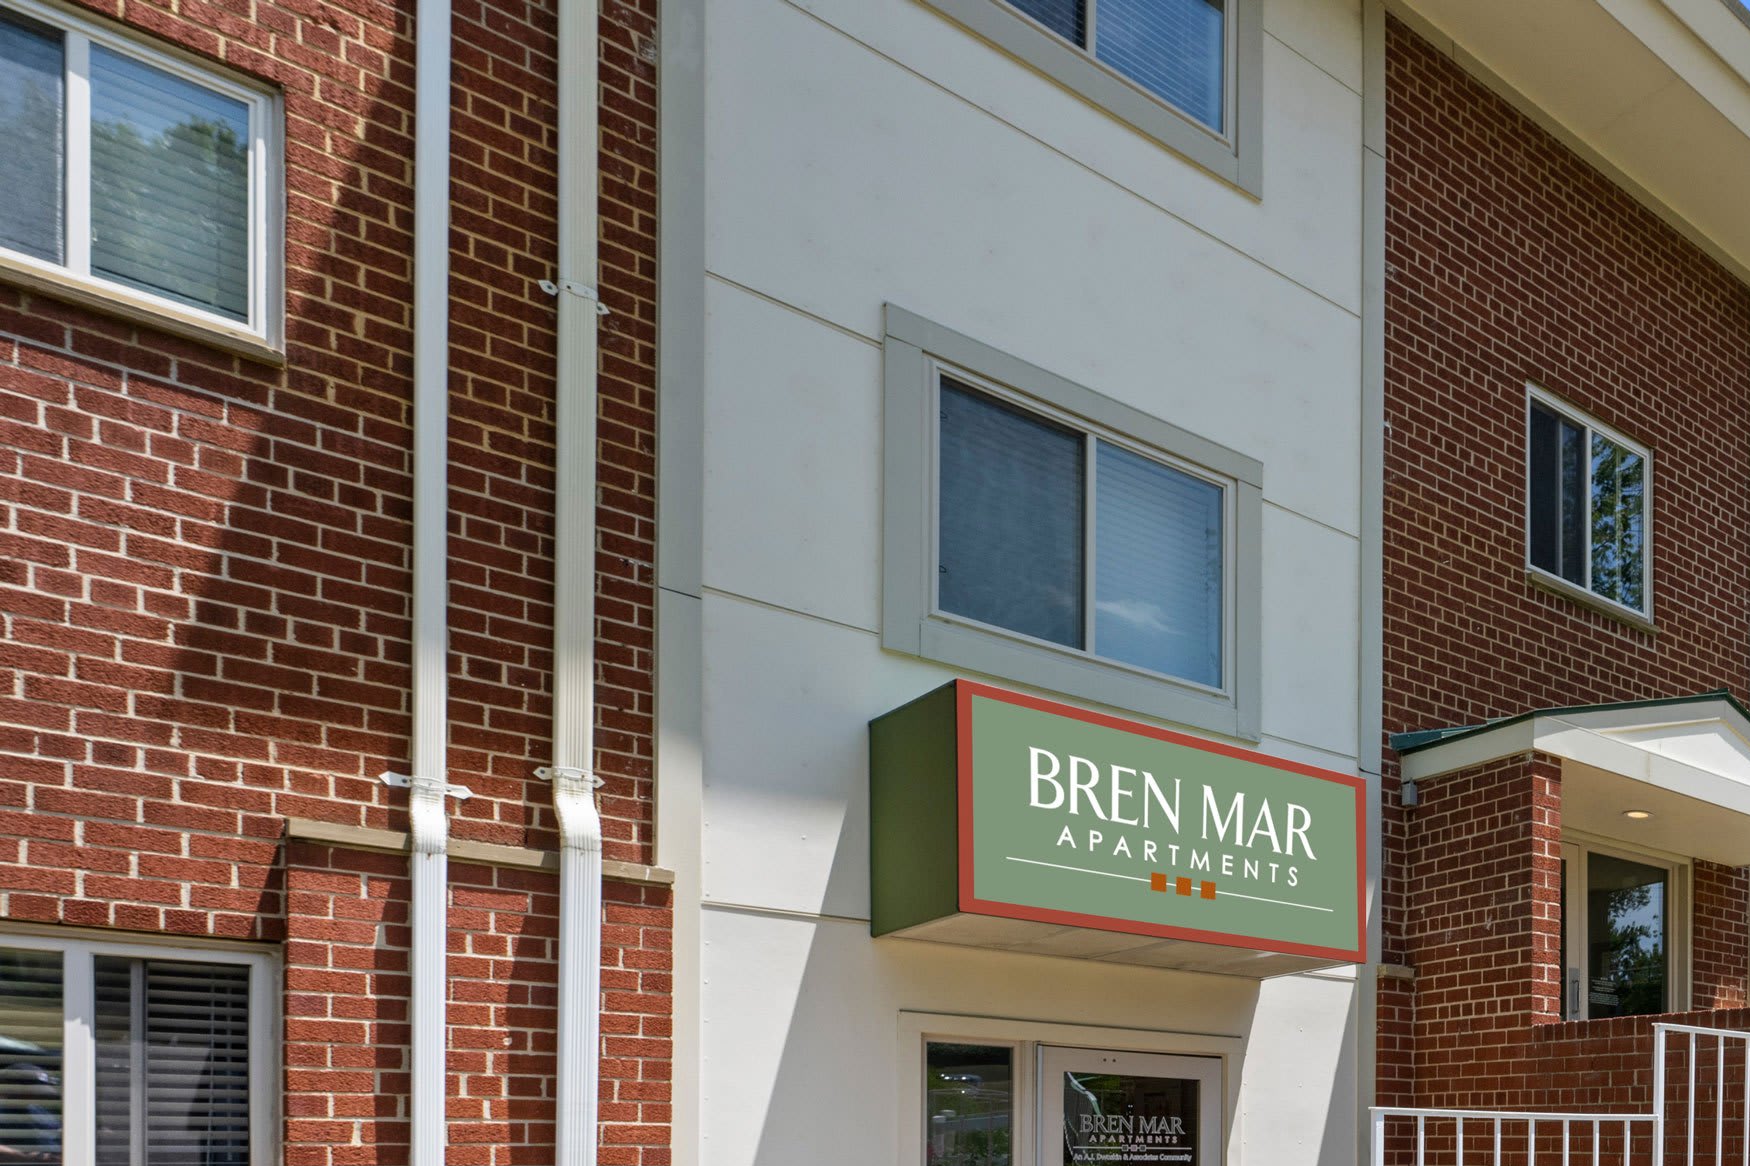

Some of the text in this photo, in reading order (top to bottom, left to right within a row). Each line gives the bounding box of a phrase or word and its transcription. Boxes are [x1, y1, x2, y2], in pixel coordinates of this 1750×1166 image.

[1028, 746, 1317, 860] BREN MAR
[1056, 825, 1298, 887] APARTMENTS
[1080, 1114, 1185, 1134] BREN MAR
[1089, 1135, 1178, 1144] APARTMENTS
[1160, 1153, 1192, 1162] Community
